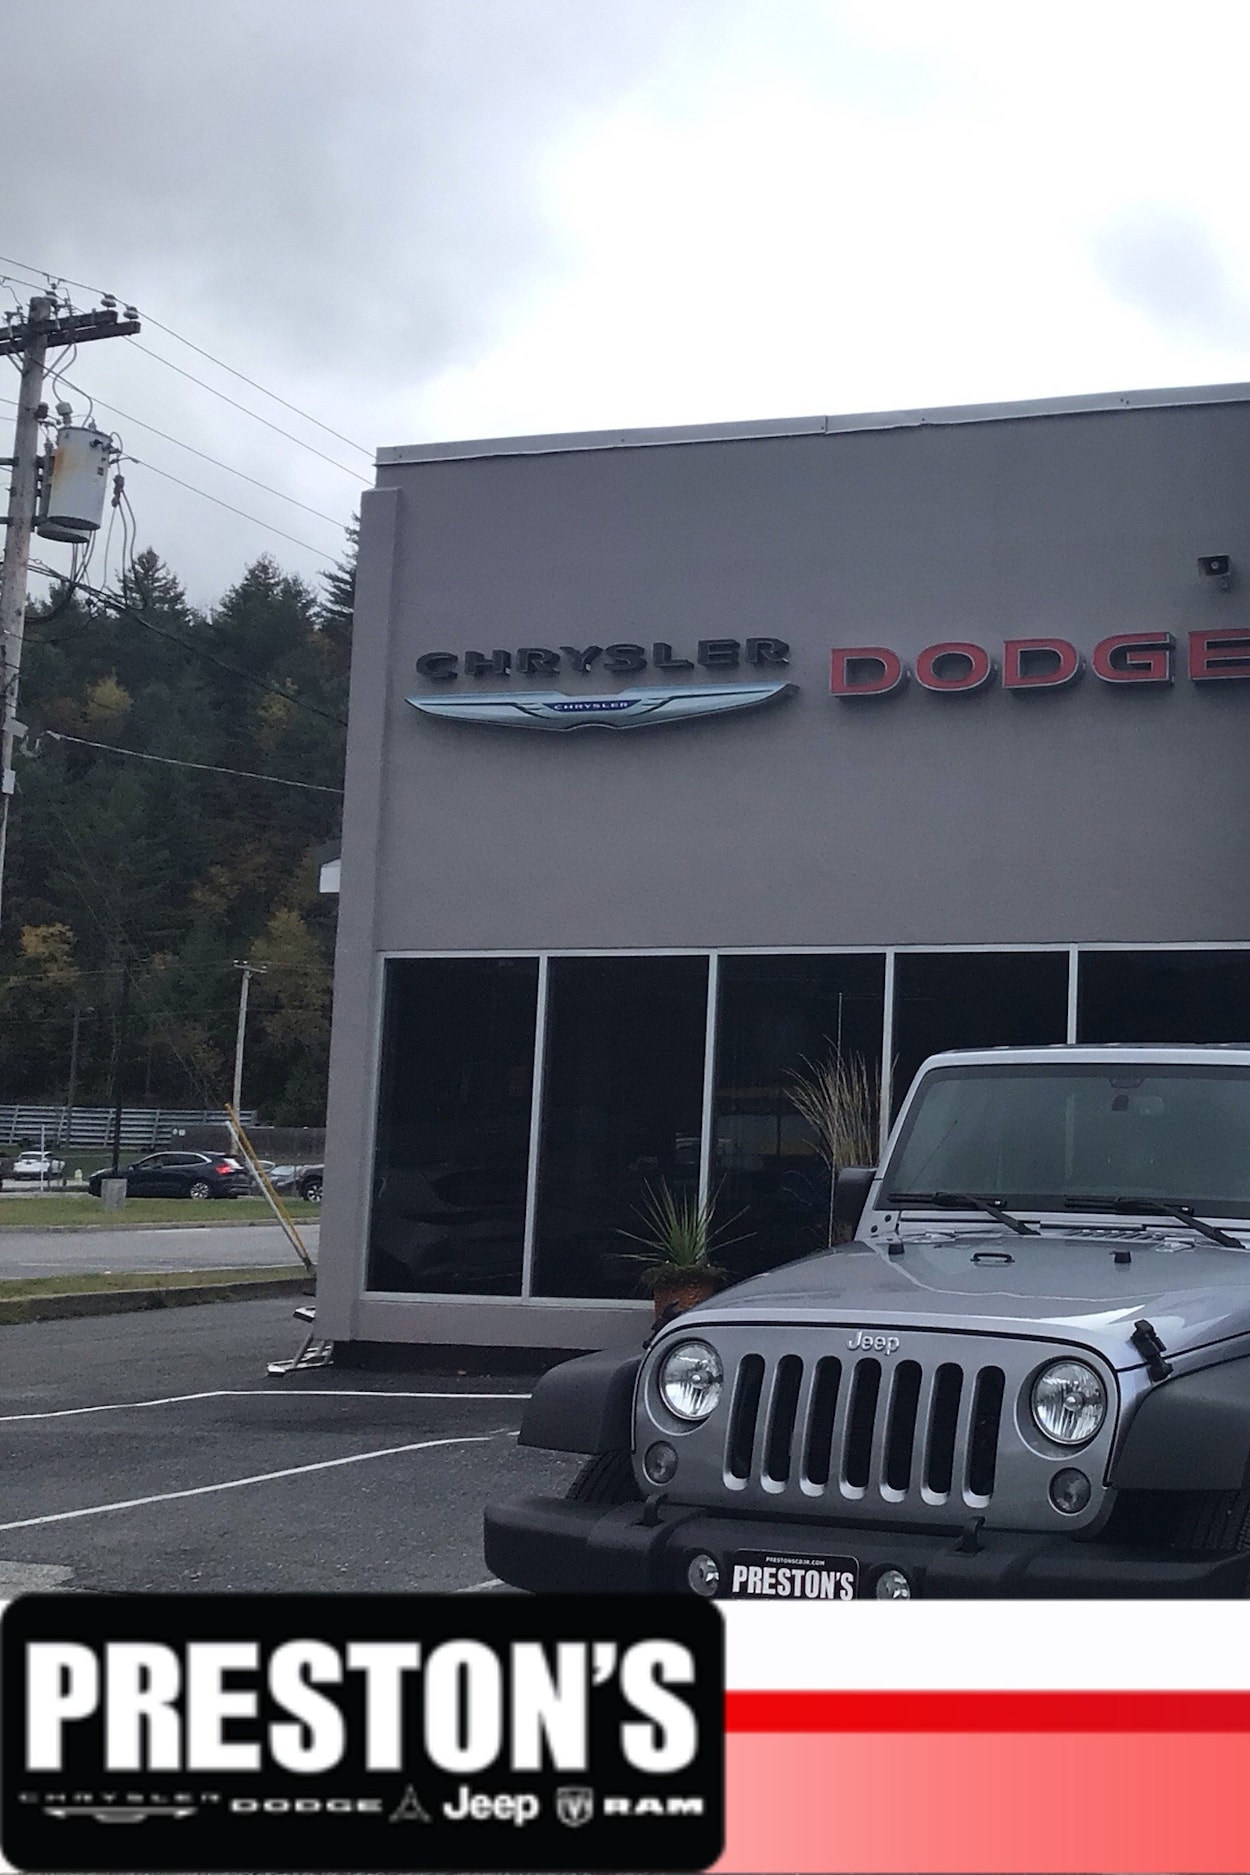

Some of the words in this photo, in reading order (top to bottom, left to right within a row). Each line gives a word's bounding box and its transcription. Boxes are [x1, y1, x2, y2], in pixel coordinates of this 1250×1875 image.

[415, 637, 790, 680] CHRYSLER
[554, 702, 628, 710] CHRYSLER
[847, 1330, 900, 1356] Jeep
[732, 1565, 854, 1600] PRESTON'S
